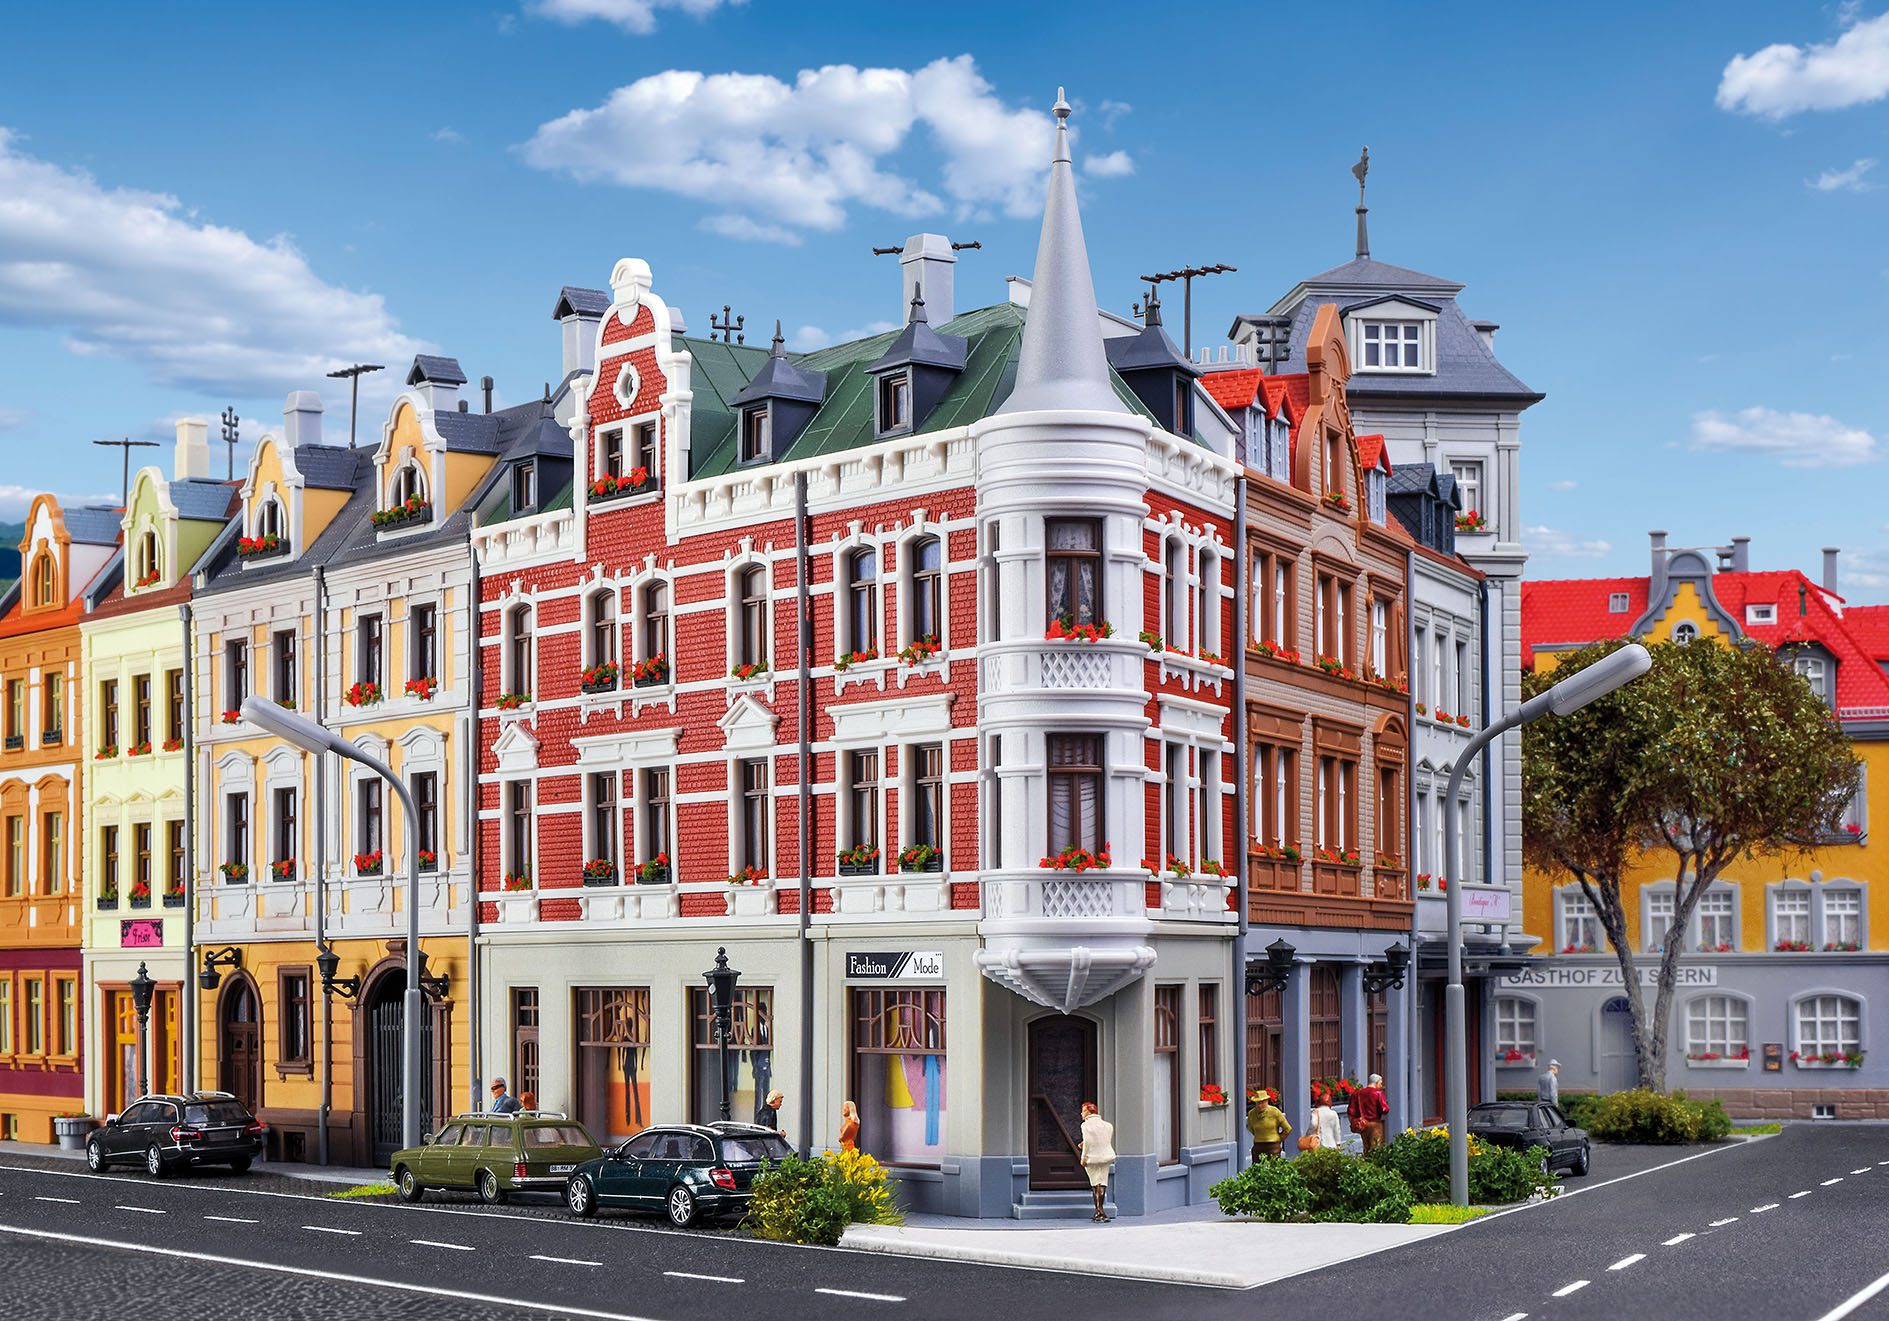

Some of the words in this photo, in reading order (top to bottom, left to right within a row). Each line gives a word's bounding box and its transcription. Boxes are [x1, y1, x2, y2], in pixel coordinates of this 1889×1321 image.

[850, 956, 887, 974] Fashion
[913, 957, 940, 974] Mode
[1648, 968, 1712, 984] SERN
